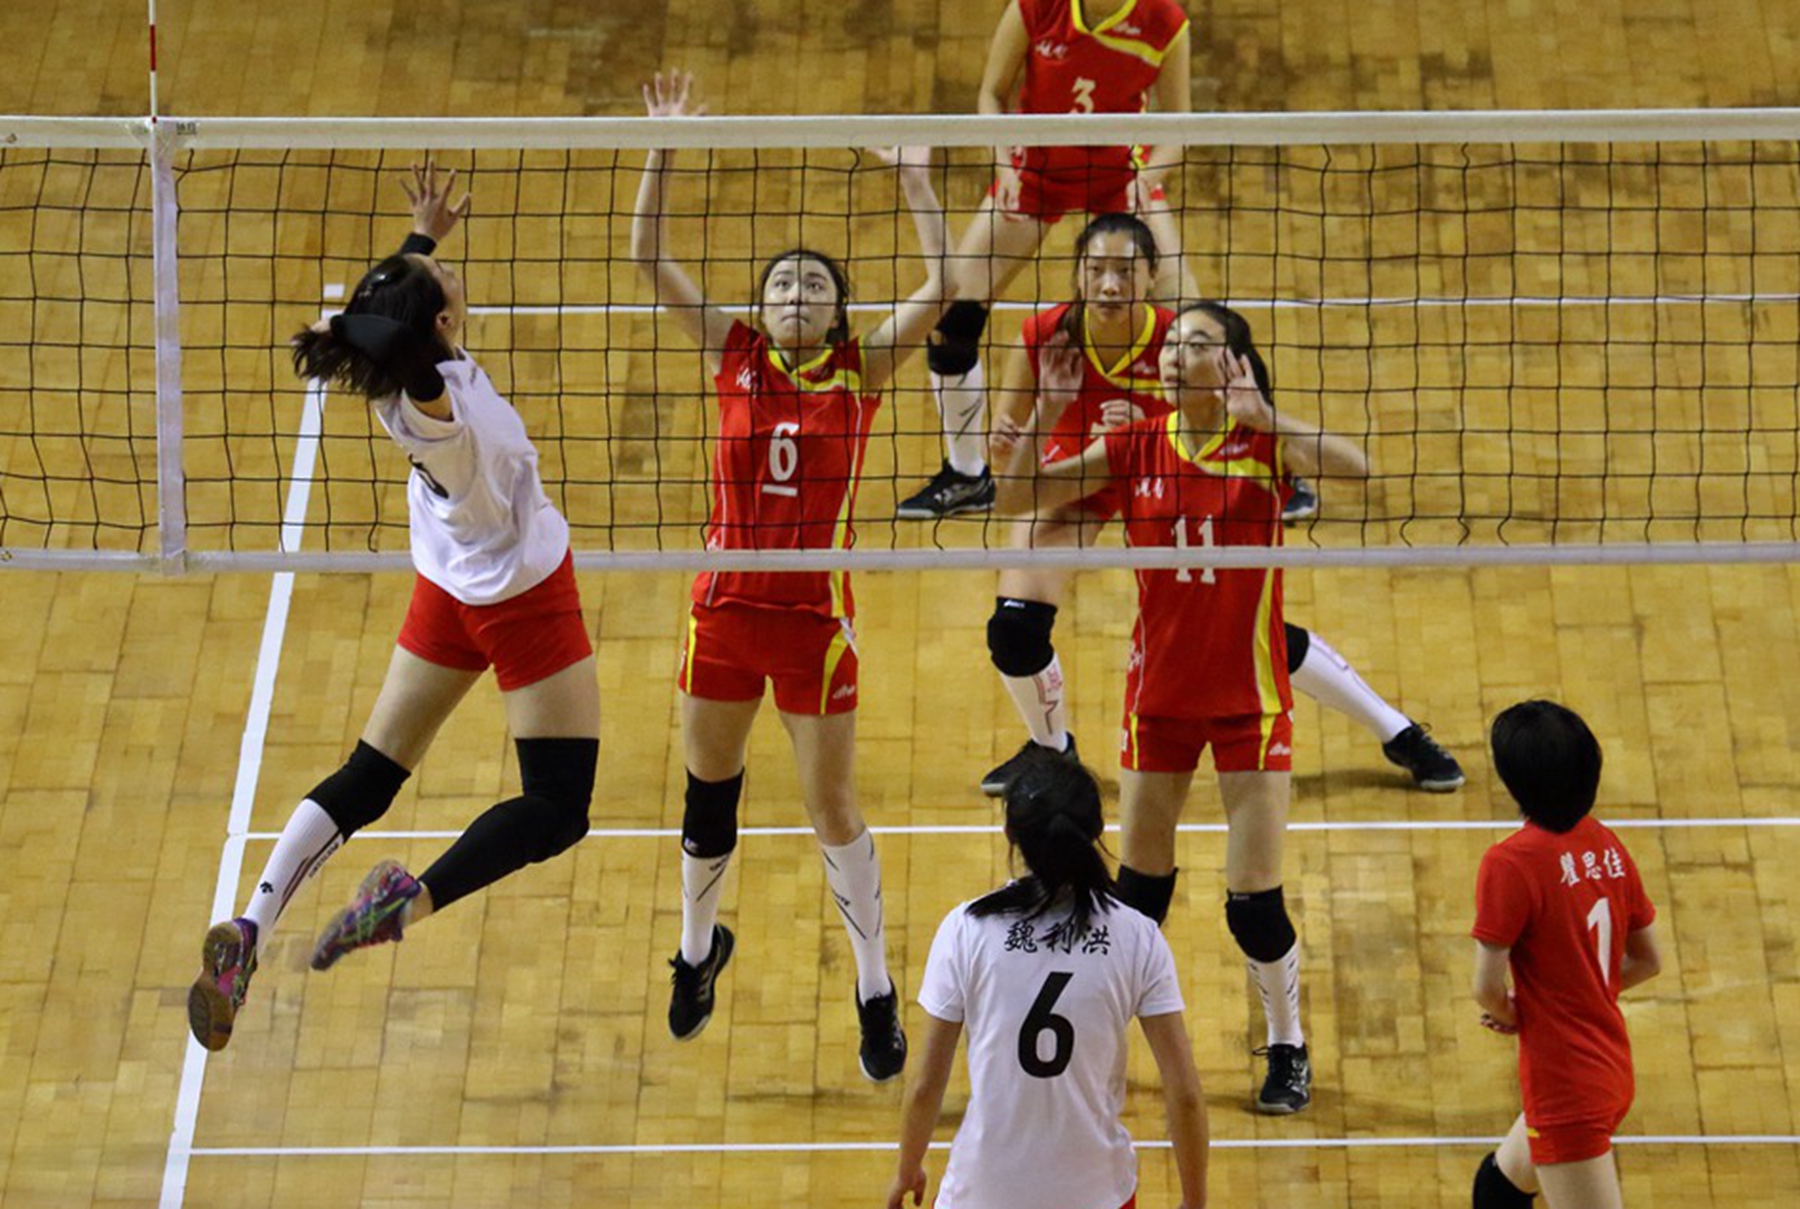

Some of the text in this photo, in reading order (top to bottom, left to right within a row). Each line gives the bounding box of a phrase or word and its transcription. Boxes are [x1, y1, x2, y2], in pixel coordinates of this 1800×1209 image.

[1069, 76, 1096, 113] 3
[769, 421, 799, 482] 6
[1170, 514, 1217, 585] 11
[1586, 896, 1612, 988] 1
[1018, 971, 1075, 1079] 6
